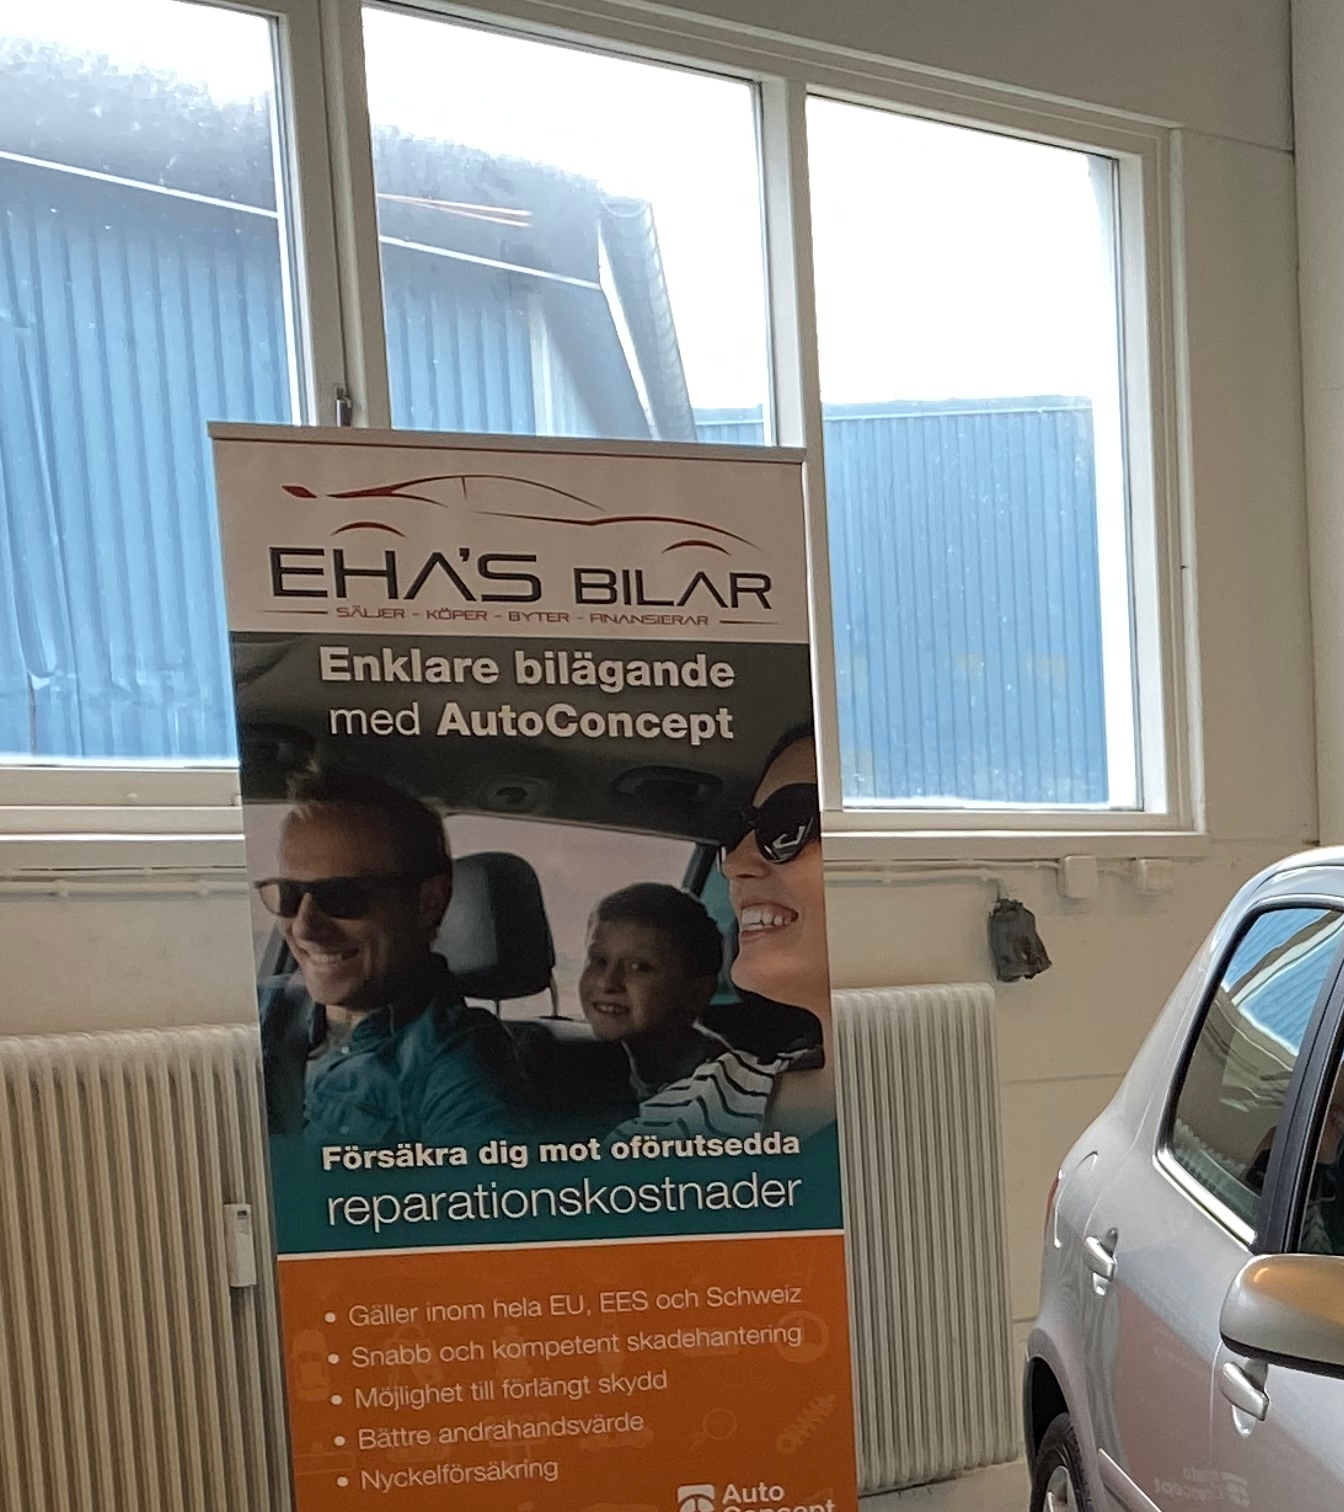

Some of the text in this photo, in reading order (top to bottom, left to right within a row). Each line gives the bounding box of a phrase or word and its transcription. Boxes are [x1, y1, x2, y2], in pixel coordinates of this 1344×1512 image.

[268, 546, 773, 610] EHA'S BILAR
[336, 604, 709, 627] SÄLJER KÖPER BYTER FINANSIERAR
[319, 646, 736, 693] Enklare bilägande
[330, 701, 735, 746] med AutoConcept
[321, 1131, 800, 1170] Försäkra dig mot oförutsedda
[328, 1171, 803, 1232] reparationskostnader
[349, 1284, 802, 1327] Gäller inom hela EU, EES och Schweiz
[352, 1323, 802, 1368] Snabb och kompetent skadehantering
[354, 1369, 668, 1411] Möjlighet till förlängt skydd
[358, 1412, 644, 1450] Bättre andrahandsvärde
[360, 1458, 559, 1494] Nyckelförsäkring
[722, 1481, 785, 1504] Auto
